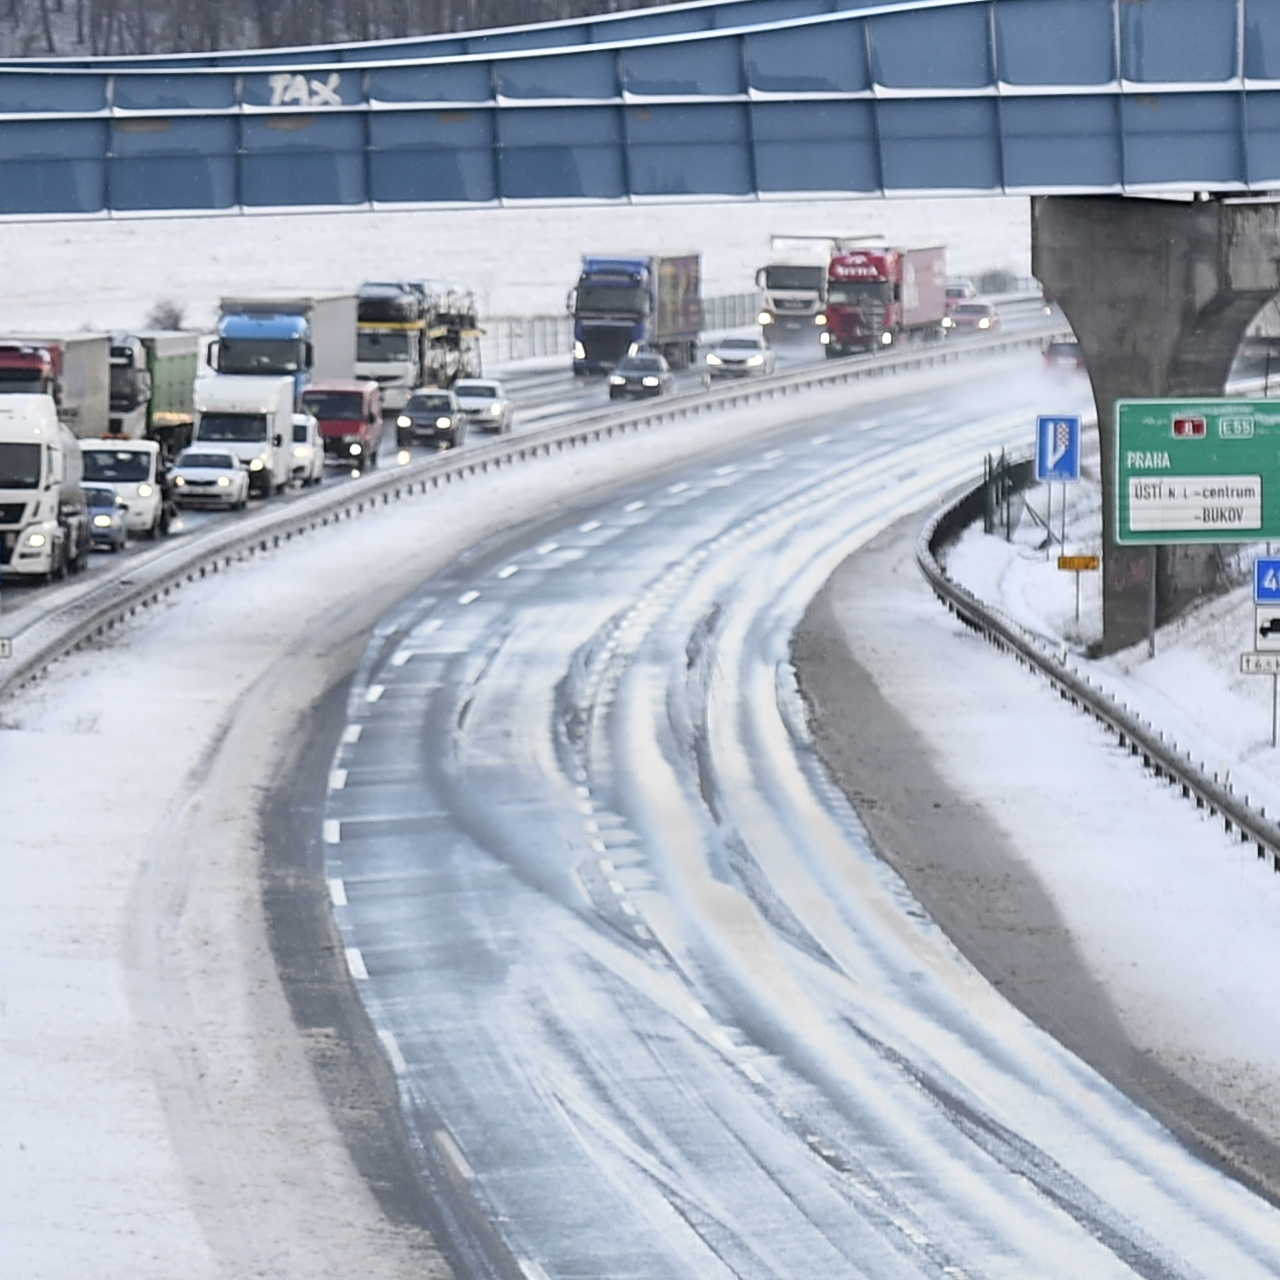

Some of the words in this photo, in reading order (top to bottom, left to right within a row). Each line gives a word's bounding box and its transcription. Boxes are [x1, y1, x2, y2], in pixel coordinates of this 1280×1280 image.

[269, 73, 342, 106] TAX
[1127, 450, 1171, 469] PRAHA
[1262, 568, 1280, 592] 4
